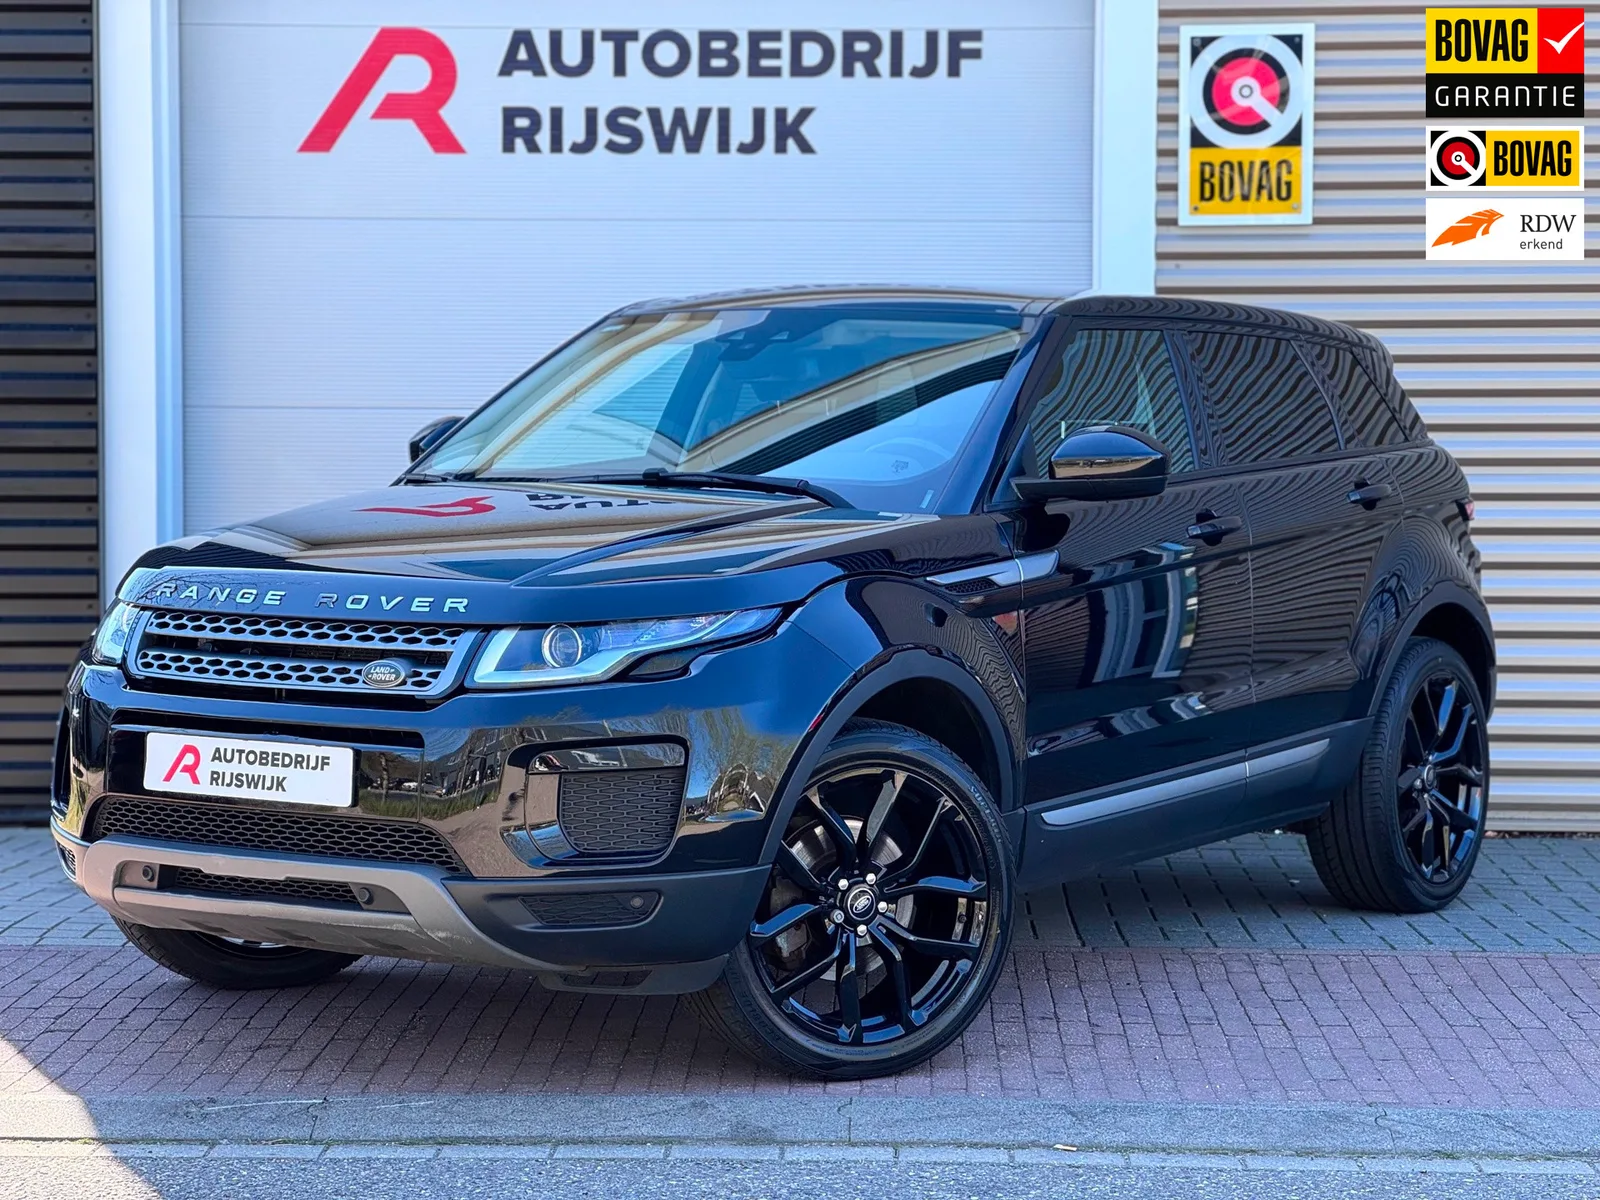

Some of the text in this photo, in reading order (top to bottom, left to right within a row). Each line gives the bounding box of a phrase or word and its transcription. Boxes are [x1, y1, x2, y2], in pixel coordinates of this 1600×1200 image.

[498, 29, 983, 79] AUTOBEDRIJF
[502, 106, 816, 155] RIJSWIJK
[1199, 159, 1293, 203] BOVAG
[156, 583, 469, 614] RANGE ROVER
[371, 673, 396, 681] ROVER
[210, 747, 331, 772] AUTOBEDRIJF
[209, 770, 288, 793] RIJSWIJK
